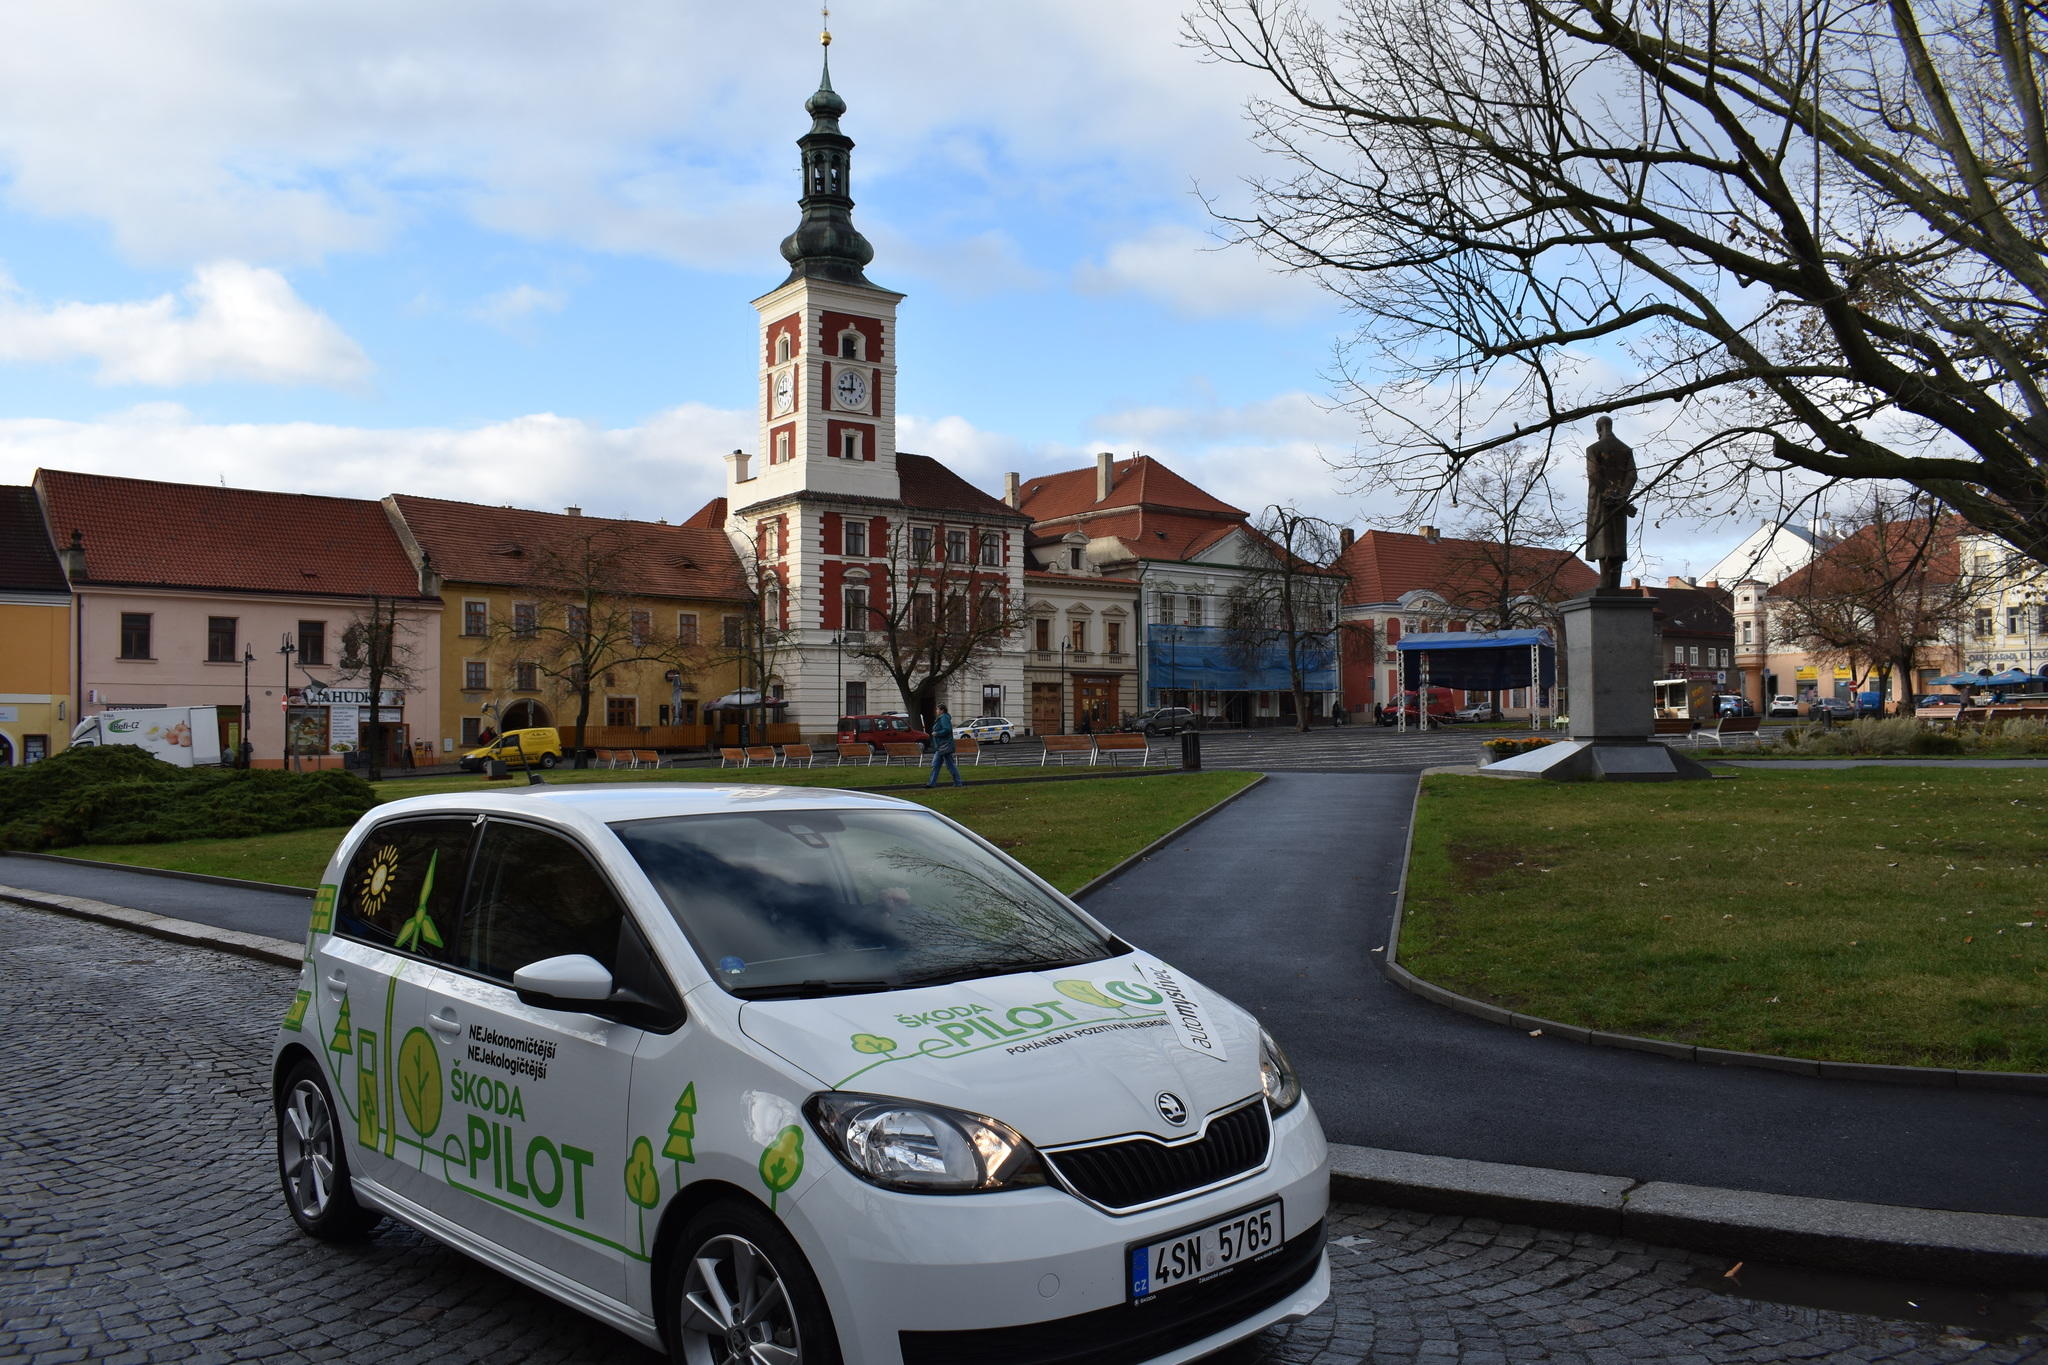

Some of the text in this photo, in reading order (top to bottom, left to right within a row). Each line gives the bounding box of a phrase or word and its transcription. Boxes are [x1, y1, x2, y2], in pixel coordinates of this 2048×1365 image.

[896, 1002, 993, 1029] ŠKODA
[1149, 966, 1213, 1050] automyslivec
[469, 1024, 558, 1060] NEJekonomičtější
[1005, 1031, 1077, 1056] POHÁNĚNÁ
[1074, 1021, 1128, 1038] POZITIVNÍ
[467, 1044, 548, 1081] NEJekologičtější
[451, 1058, 526, 1122] ŠKODA
[1155, 1209, 1272, 1284] 4SN 5765
[1134, 1279, 1147, 1293] CZ
